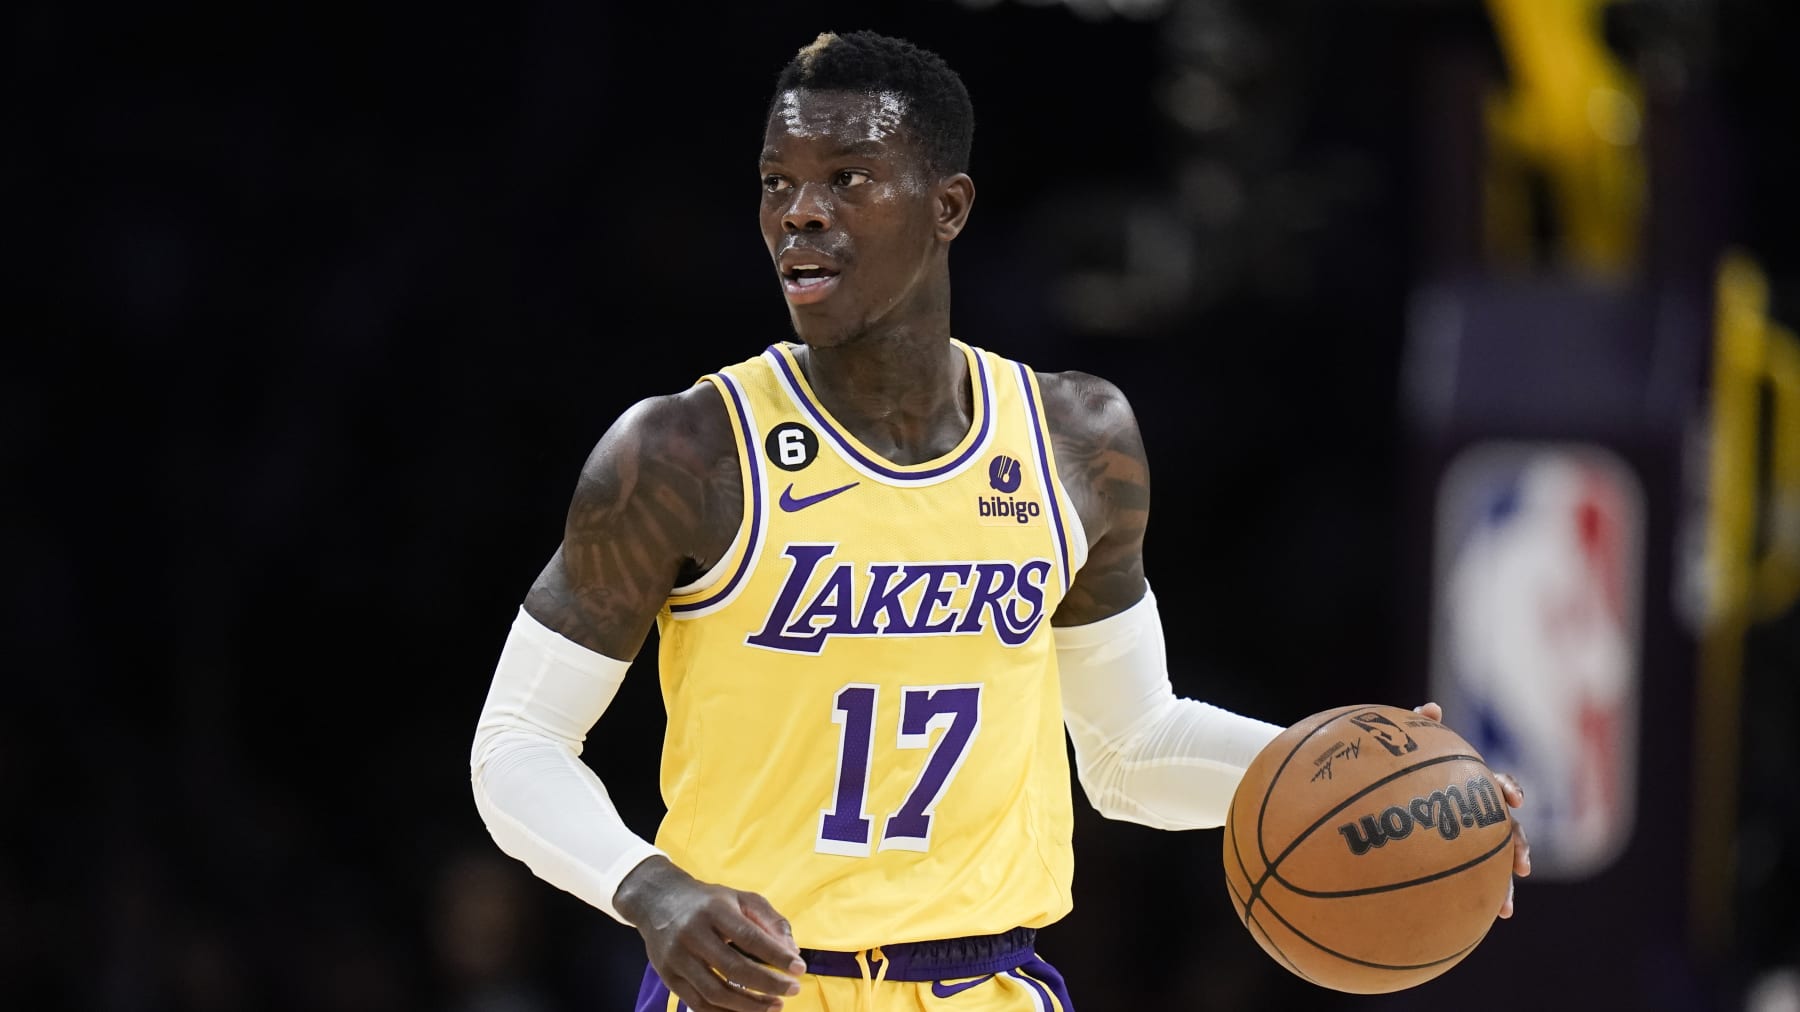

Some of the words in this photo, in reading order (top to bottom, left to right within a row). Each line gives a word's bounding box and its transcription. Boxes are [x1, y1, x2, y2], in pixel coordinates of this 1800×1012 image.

[778, 428, 808, 466] 6
[978, 496, 1040, 524] bibigo
[744, 543, 1055, 655] LAKERS
[815, 682, 985, 857] 17
[1339, 775, 1506, 856] Wilson
